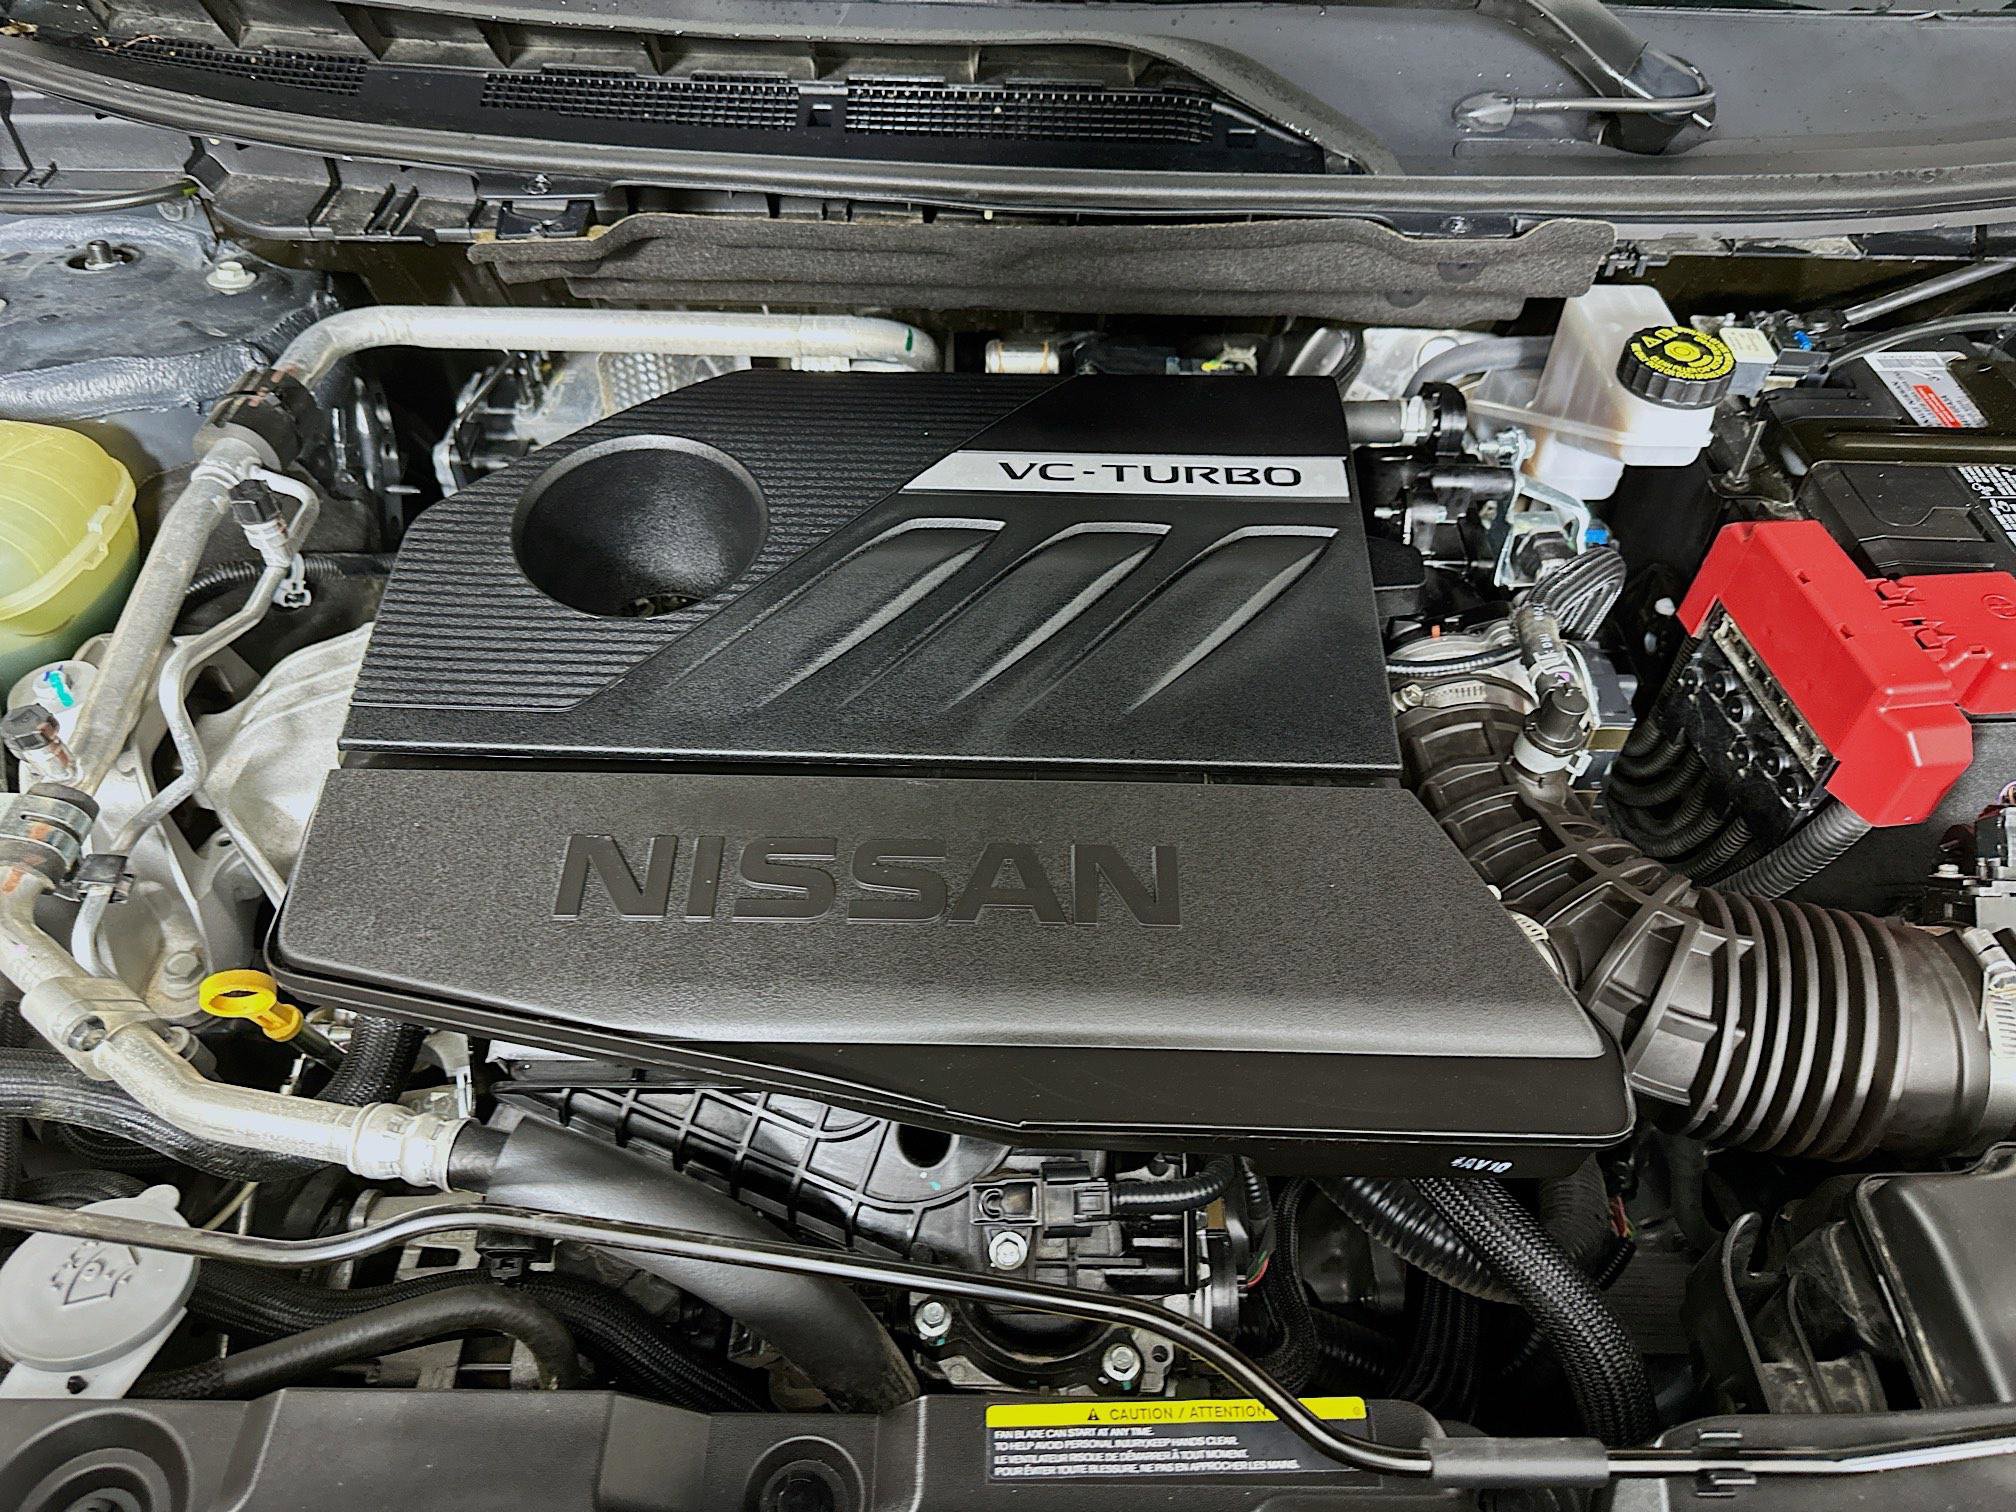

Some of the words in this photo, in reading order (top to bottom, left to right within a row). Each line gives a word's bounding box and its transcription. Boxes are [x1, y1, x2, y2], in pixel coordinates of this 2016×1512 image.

[998, 462, 1302, 487] VC-TURBO
[552, 834, 1182, 929] NISSAN
[1109, 1407, 1173, 1420] CAUTION
[1190, 1405, 1268, 1418] ATTENTION
[993, 1430, 1014, 1439] FAN
[1014, 1429, 1045, 1439] BLADE
[1046, 1428, 1067, 1438] CAN
[1067, 1428, 1097, 1438] START
[1110, 1427, 1130, 1437] ANY
[994, 1441, 1009, 1451] TO
[1009, 1440, 1035, 1450] HELP
